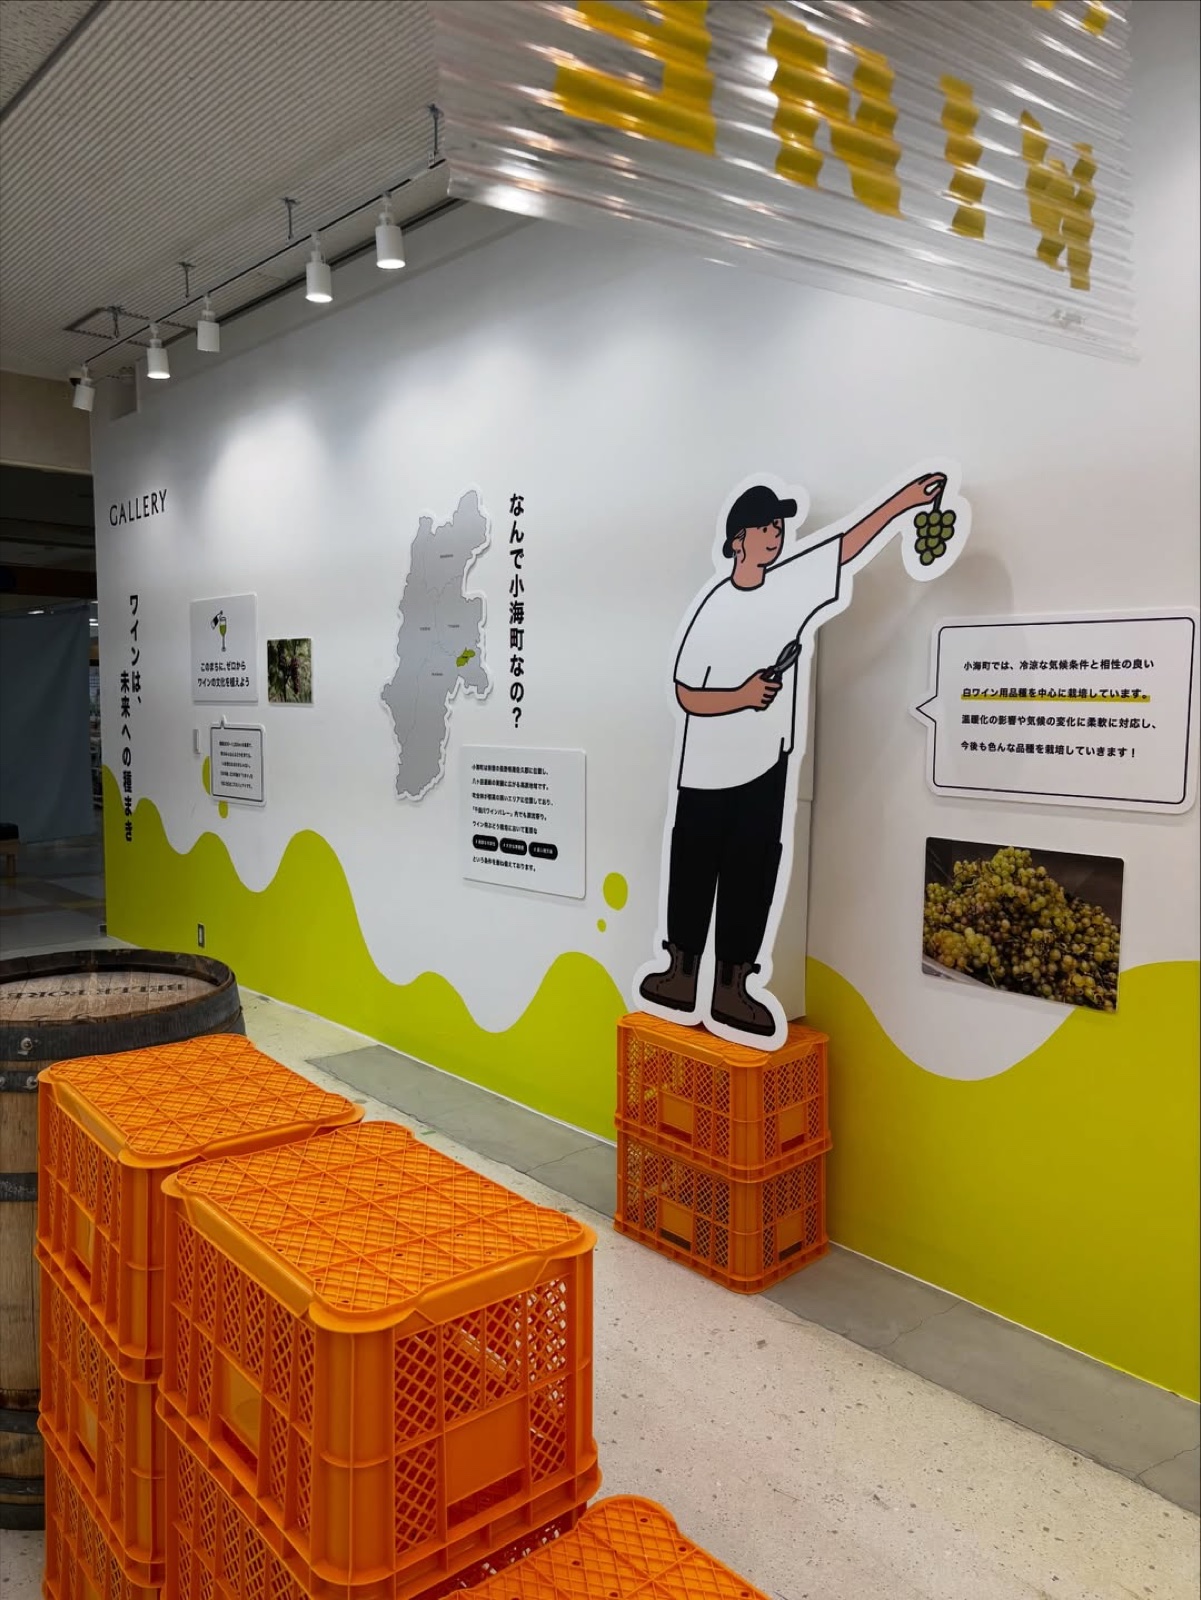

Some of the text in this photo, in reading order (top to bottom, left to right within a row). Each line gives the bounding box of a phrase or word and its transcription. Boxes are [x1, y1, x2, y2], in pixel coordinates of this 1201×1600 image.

[109, 489, 167, 527] GALLERY
[129, 594, 142, 704] ワインは、
[200, 660, 246, 672] このまちに、ゼロから
[963, 658, 1155, 672] 小海町では、冷涼な気候条件と相性の良い
[197, 677, 250, 688] ワインの文化を植えよう
[962, 687, 1149, 700] 白ワイン用品種を中心に栽培しています。
[961, 714, 1157, 730] 温暖化の影響や気候の変化に柔軟に対応し、
[120, 671, 134, 842] 未来への種まき
